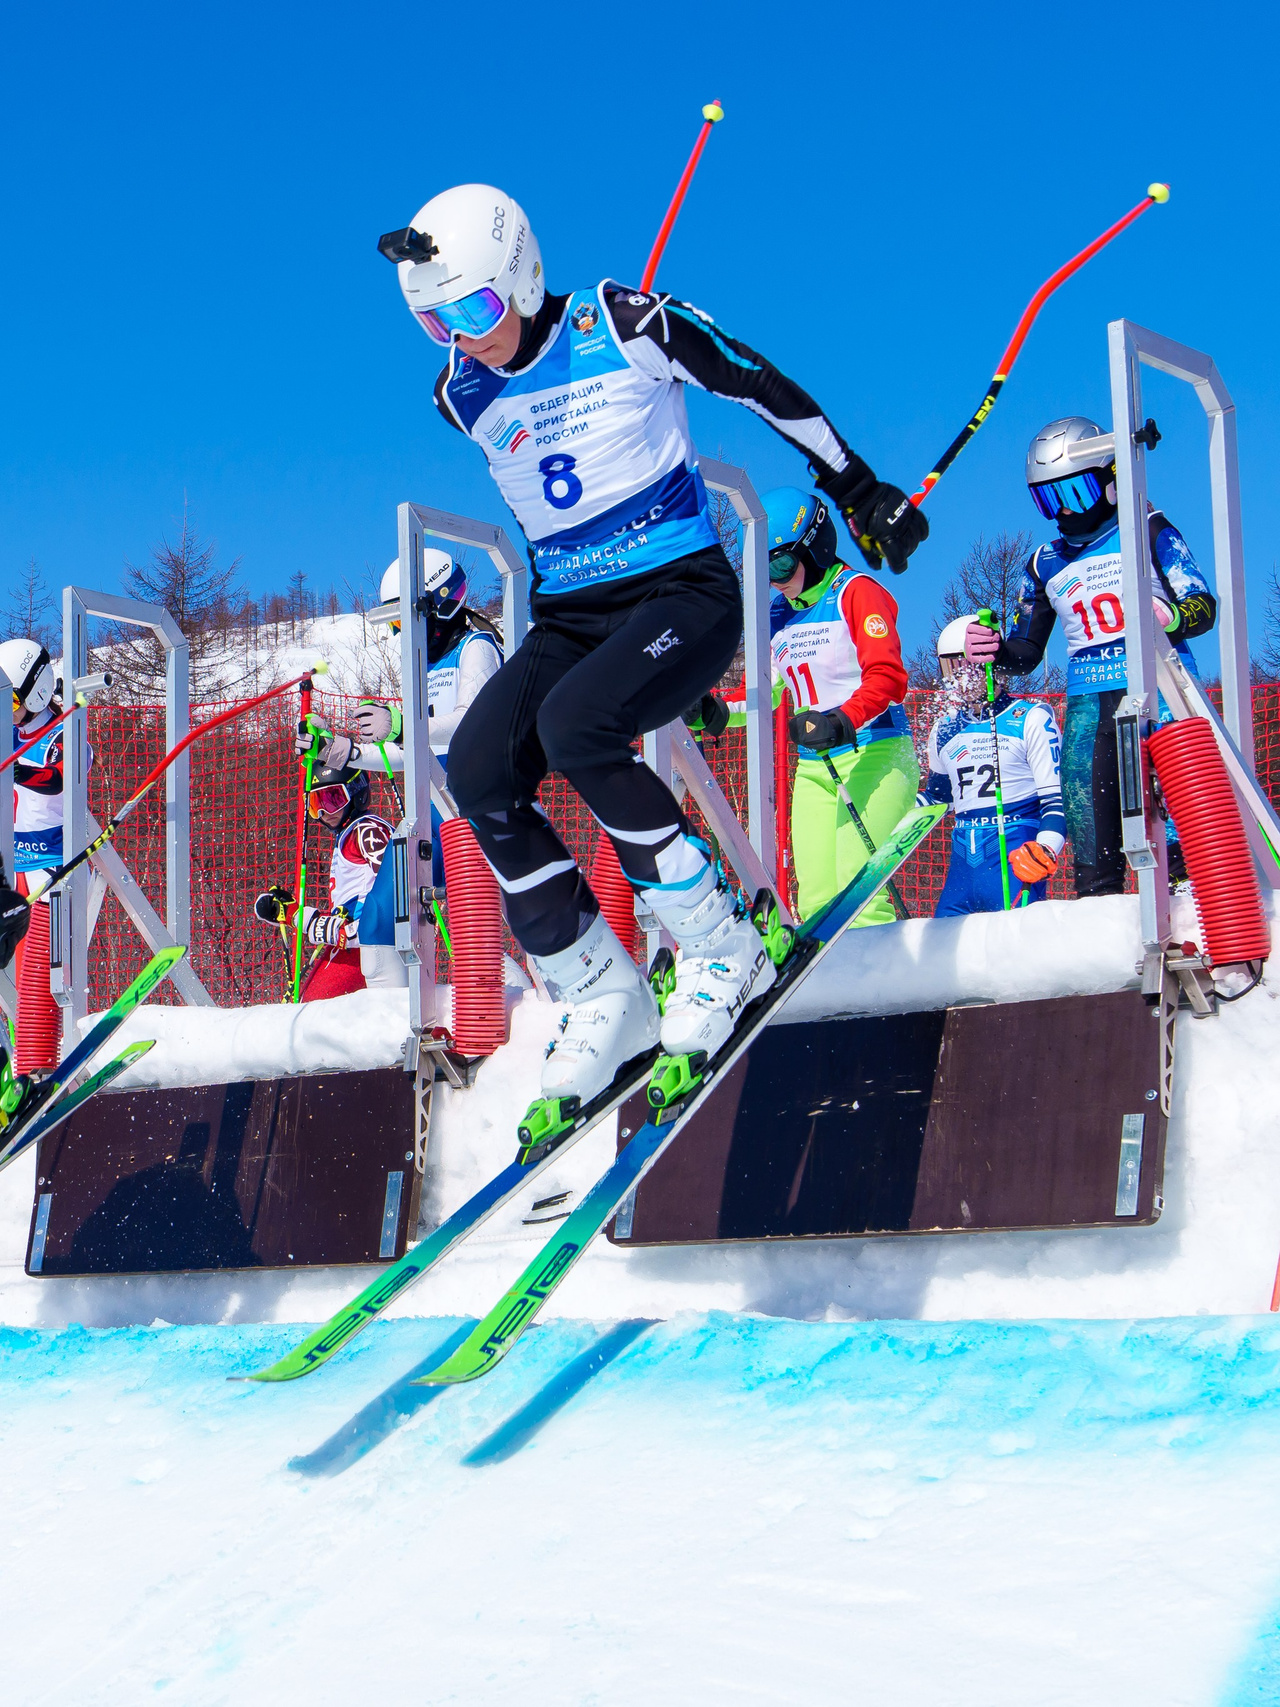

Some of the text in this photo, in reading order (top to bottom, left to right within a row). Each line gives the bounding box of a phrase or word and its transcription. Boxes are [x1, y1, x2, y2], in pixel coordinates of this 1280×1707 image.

[509, 224, 526, 275] SMITH
[530, 382, 604, 414] ФЕДЕРАЦИЯ
[967, 395, 996, 432] LEKI
[534, 399, 609, 431] ФРИСТАЙЛА
[535, 422, 589, 447] РОССИИ
[538, 453, 583, 510] 8
[887, 499, 909, 525] LEKI
[424, 563, 450, 587] HEAD
[560, 559, 629, 584] ОБЛАСТЬ
[1086, 579, 1120, 592] РОССИИ
[791, 627, 830, 639] ФЕДЕРАЦИЯ
[1072, 593, 1125, 641] 10
[790, 638, 830, 650] ФРИСТАЙЛА
[790, 650, 817, 660] РОССИИ
[786, 662, 819, 708] 11
[988, 708, 999, 783] KOMPERDELL
[956, 764, 996, 800] F2
[577, 957, 613, 993] HEAD
[726, 949, 767, 1020] HEAD
